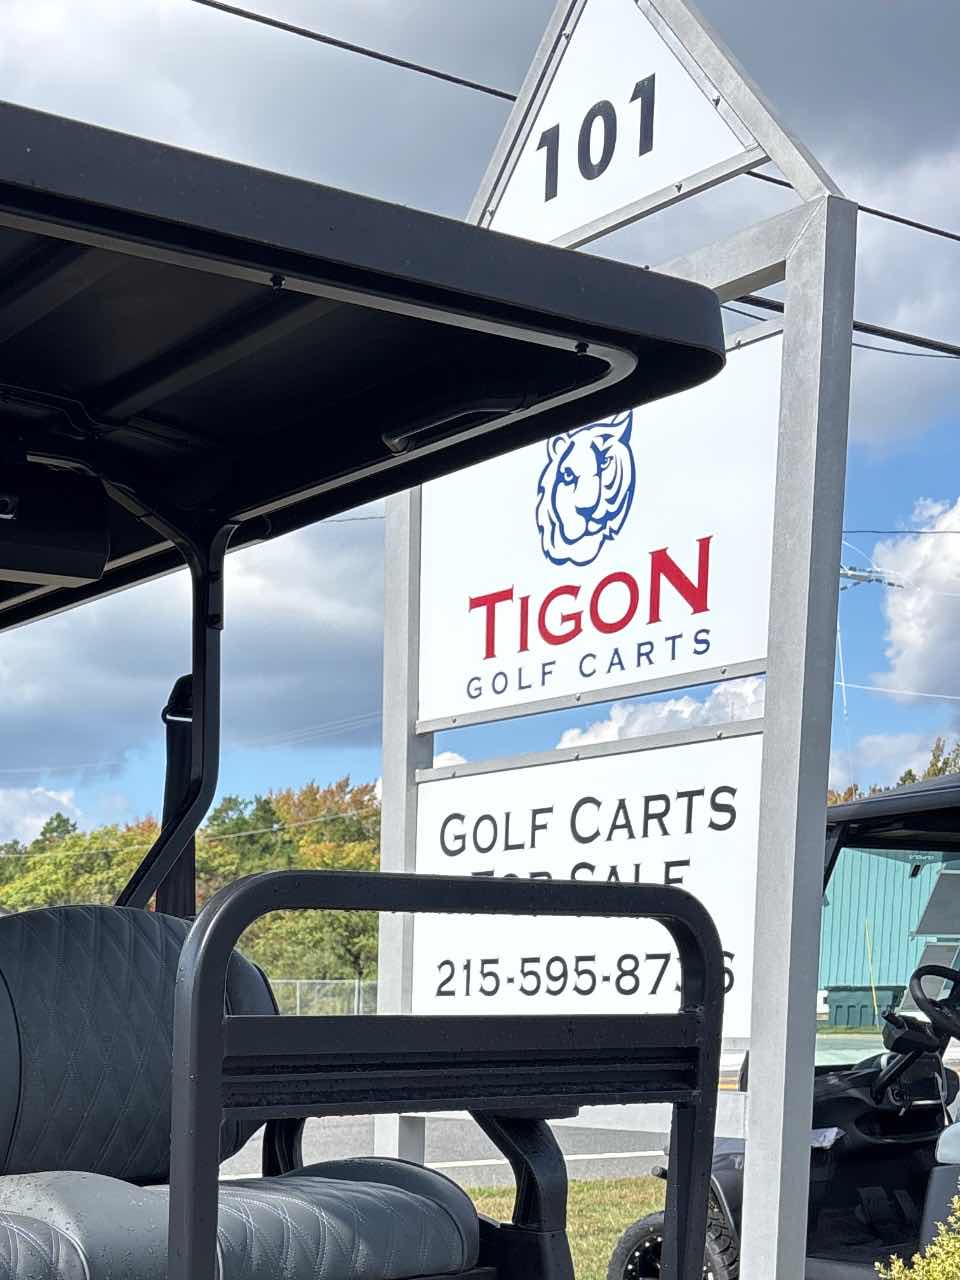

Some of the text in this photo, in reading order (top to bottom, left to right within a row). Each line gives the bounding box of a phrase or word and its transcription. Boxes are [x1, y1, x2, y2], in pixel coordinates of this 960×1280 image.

[536, 72, 656, 203] 101
[468, 535, 714, 660] TIGON
[466, 629, 711, 700] GOLF CARTS
[440, 786, 738, 857] GOLF CARTS
[436, 950, 736, 997] 215-595-87
